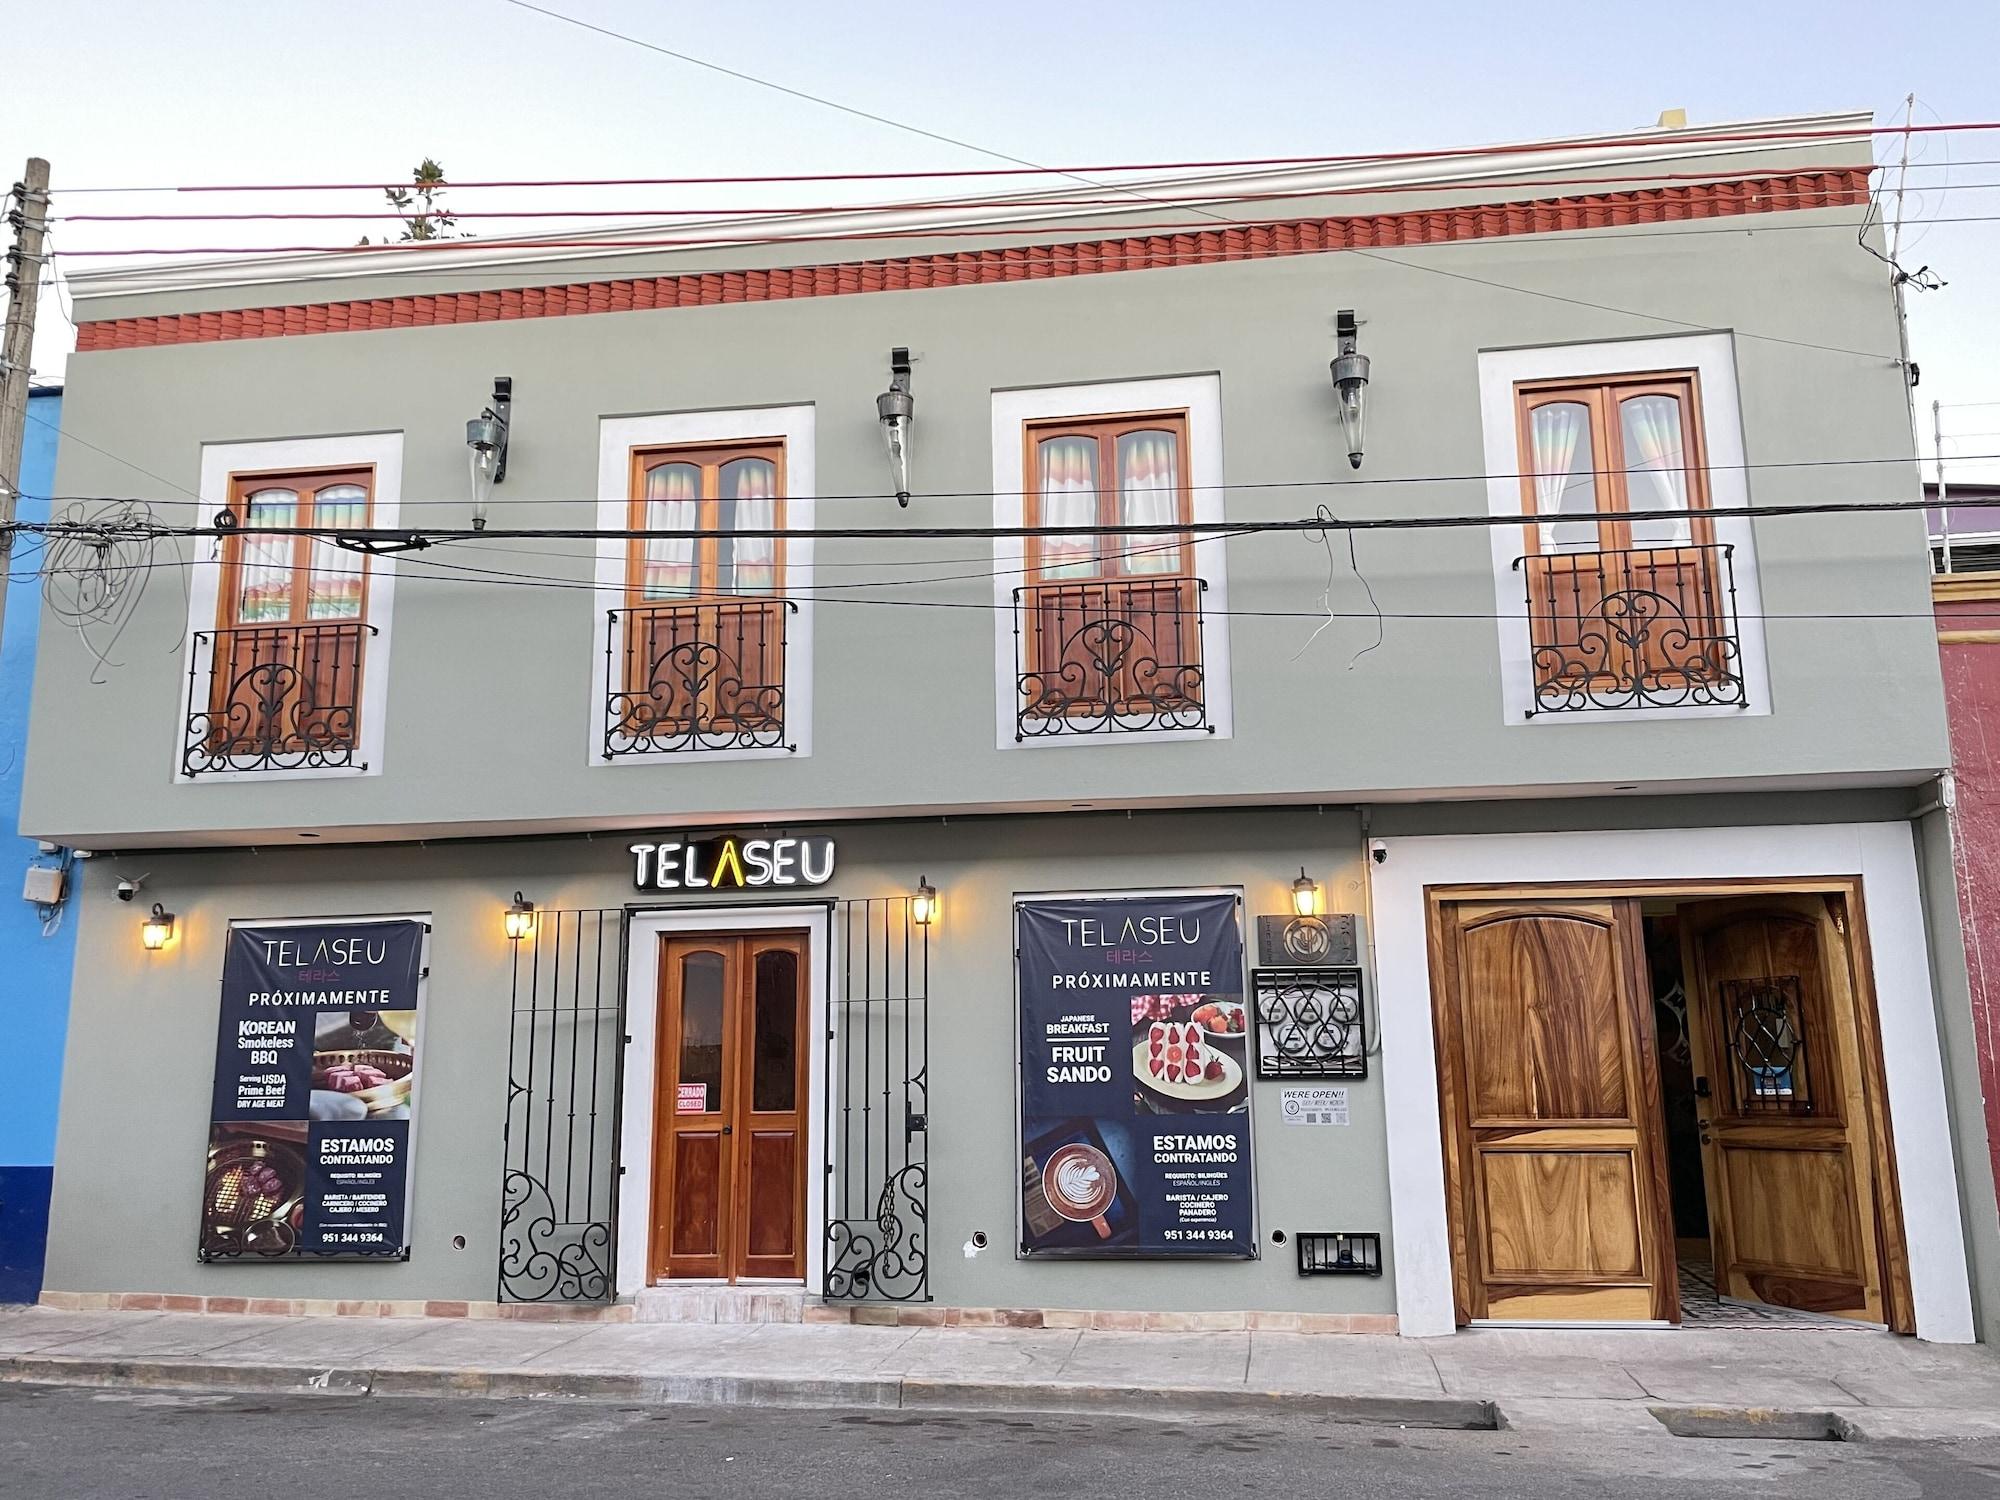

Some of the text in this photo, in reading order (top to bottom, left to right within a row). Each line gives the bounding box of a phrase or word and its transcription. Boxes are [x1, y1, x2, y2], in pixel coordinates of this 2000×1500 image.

[630, 839, 835, 888] TELASEU
[1061, 916, 1200, 947] TELASEU
[262, 938, 386, 967] TELASEU
[1106, 949, 1153, 965] 테라스
[298, 969, 341, 984] 테라스
[1052, 971, 1211, 989] PRÓXIMAMENTE
[249, 989, 390, 1006] PRÓXIMAMENTE
[238, 1020, 296, 1036] KOREAN
[1046, 1023, 1110, 1035] BREAKFAST
[238, 1036, 294, 1049] Smokeless
[250, 1050, 278, 1065] BBQ
[1052, 1046, 1105, 1062] FRUIT
[240, 1074, 286, 1084] Serving USDA
[1046, 1066, 1112, 1083] SANDO
[238, 1084, 286, 1095] Prime Beef
[1284, 1090, 1344, 1099] WERE OPEN!!
[237, 1100, 251, 1108] DRY
[321, 1138, 394, 1153] ESTAMOS
[1153, 1135, 1237, 1150] ESTAMOS
[320, 1154, 393, 1164] CONTRATANDO
[1154, 1153, 1237, 1163] CONTRATANDO
[322, 1233, 383, 1242] 951 344 9364
[1164, 1230, 1233, 1240] 951 344 9364
